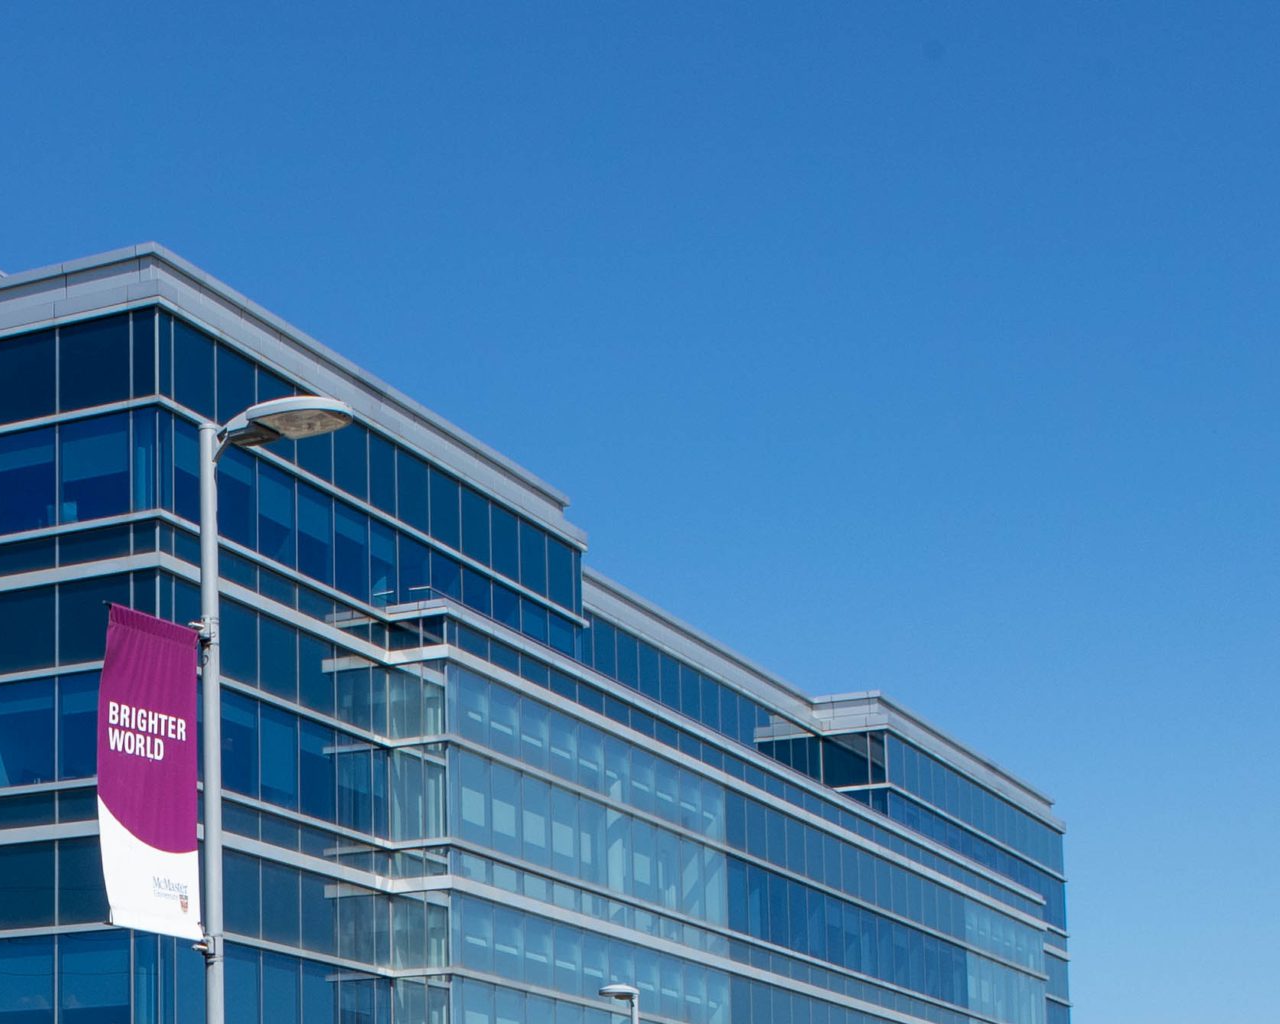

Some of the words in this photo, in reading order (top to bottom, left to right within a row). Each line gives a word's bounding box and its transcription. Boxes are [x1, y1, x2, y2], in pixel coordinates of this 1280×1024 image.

[109, 701, 186, 741] BRIGHTER
[108, 727, 164, 761] WORLD
[152, 875, 188, 896] McMaster
